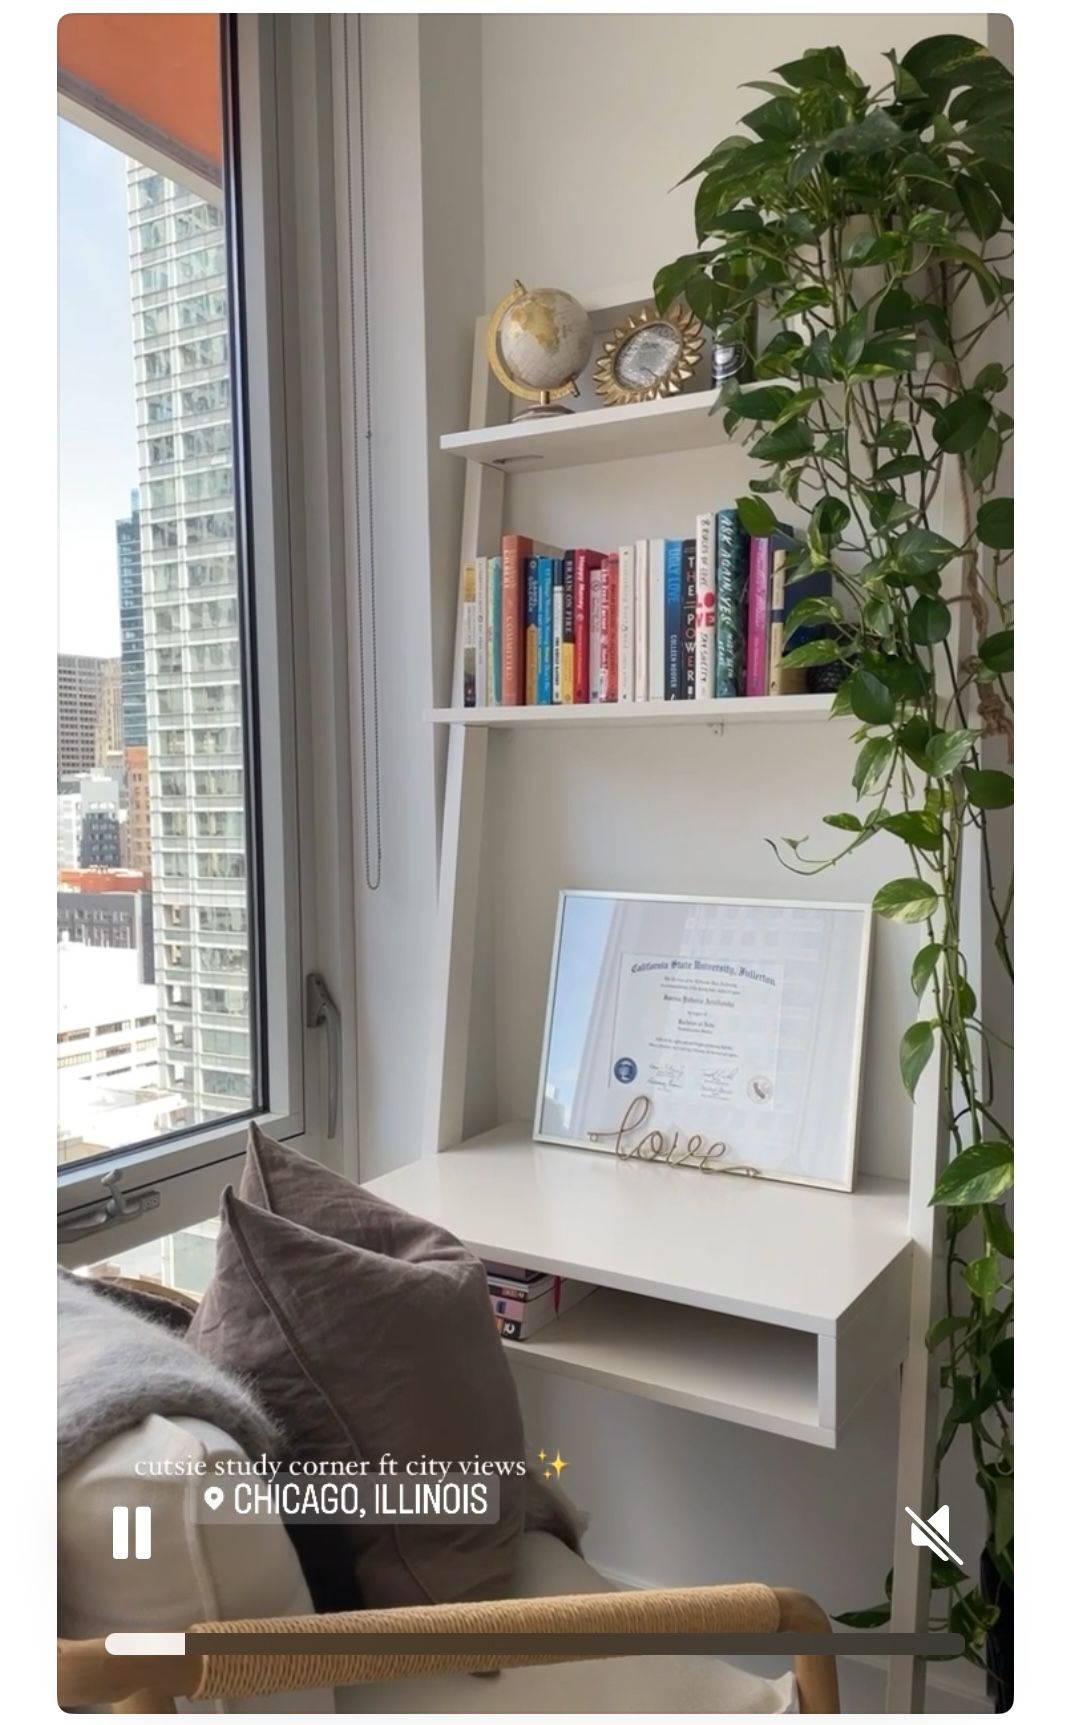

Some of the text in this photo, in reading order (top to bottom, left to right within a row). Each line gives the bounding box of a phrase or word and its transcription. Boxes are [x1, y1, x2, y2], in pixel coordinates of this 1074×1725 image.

[565, 560, 574, 634] BRAIN ON FIRE
[577, 555, 586, 610] Happy Money
[667, 548, 680, 602] UGLY LOVE
[719, 514, 734, 625] ASK AGAIN, YES
[505, 615, 515, 682] COMMITTED
[670, 634, 678, 688] COLLEEN HOOVER
[631, 960, 669, 974] California
[671, 959, 693, 971] State
[694, 960, 737, 977] University,
[738, 965, 776, 987] Fullerton
